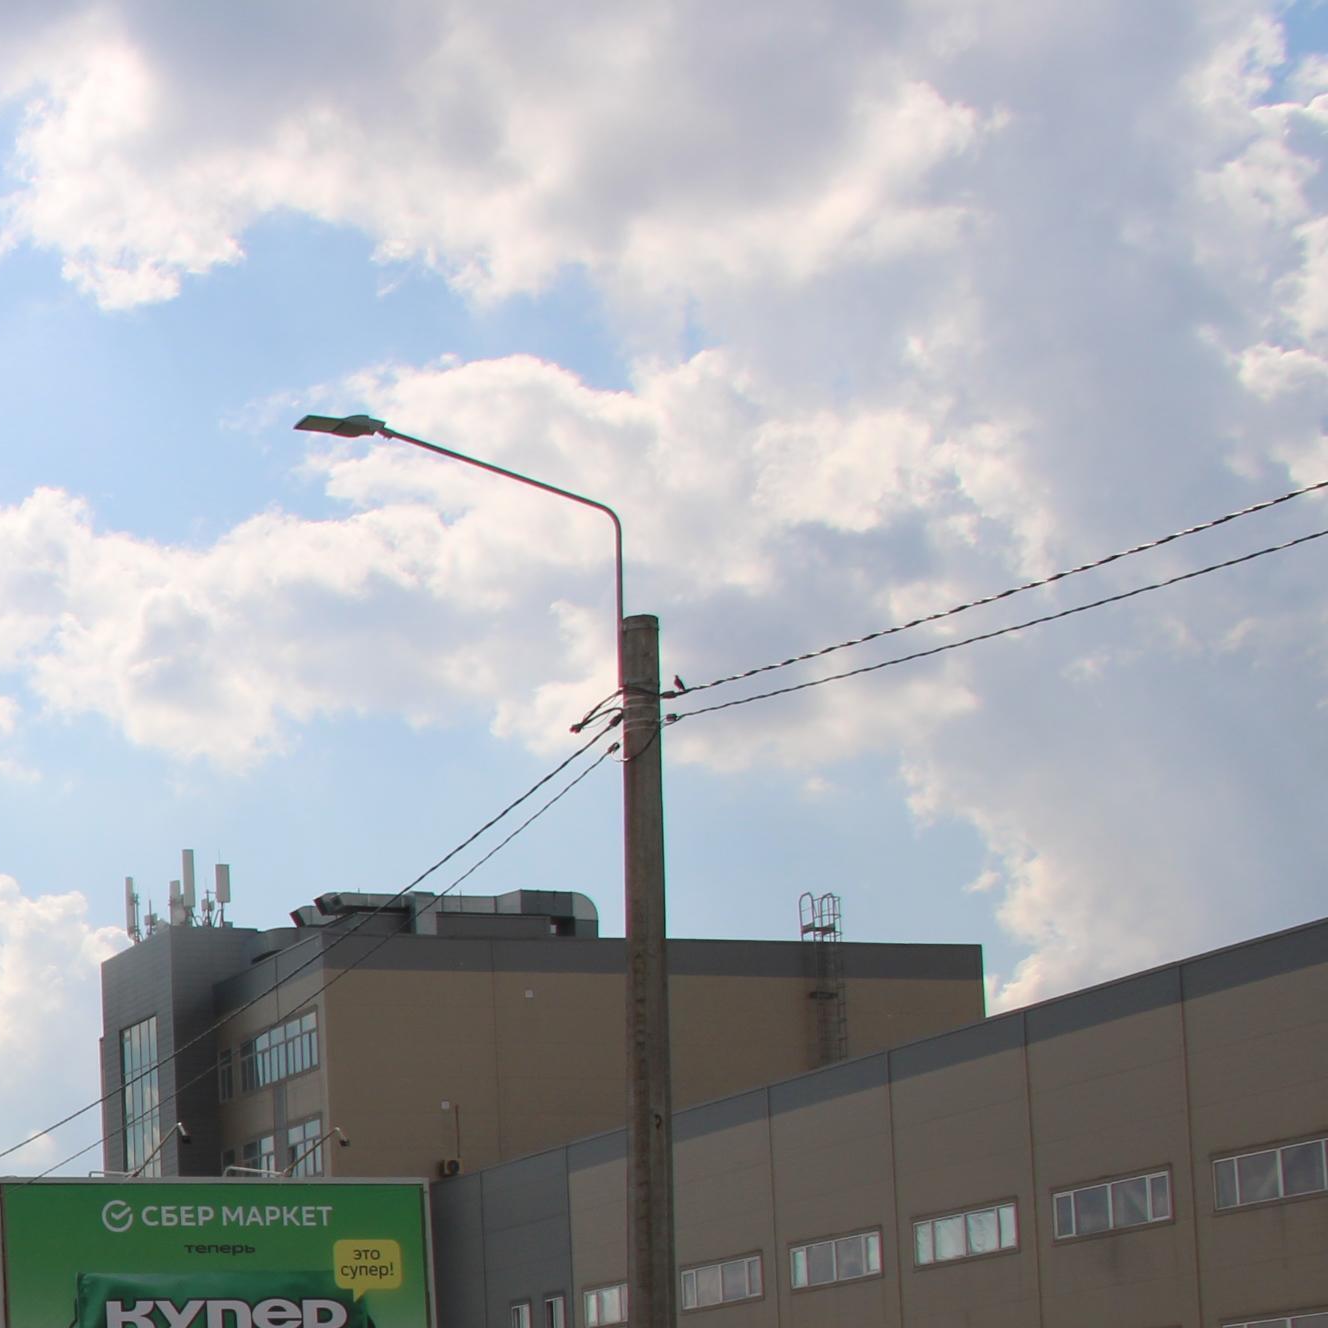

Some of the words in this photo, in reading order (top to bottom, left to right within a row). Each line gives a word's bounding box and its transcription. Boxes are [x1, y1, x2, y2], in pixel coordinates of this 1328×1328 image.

[141, 1205, 214, 1227] СБЕР
[222, 1205, 333, 1227] МАРКЕТ
[184, 1243, 256, 1256] теперь
[353, 1249, 381, 1261] это
[340, 1261, 394, 1279] супер!
